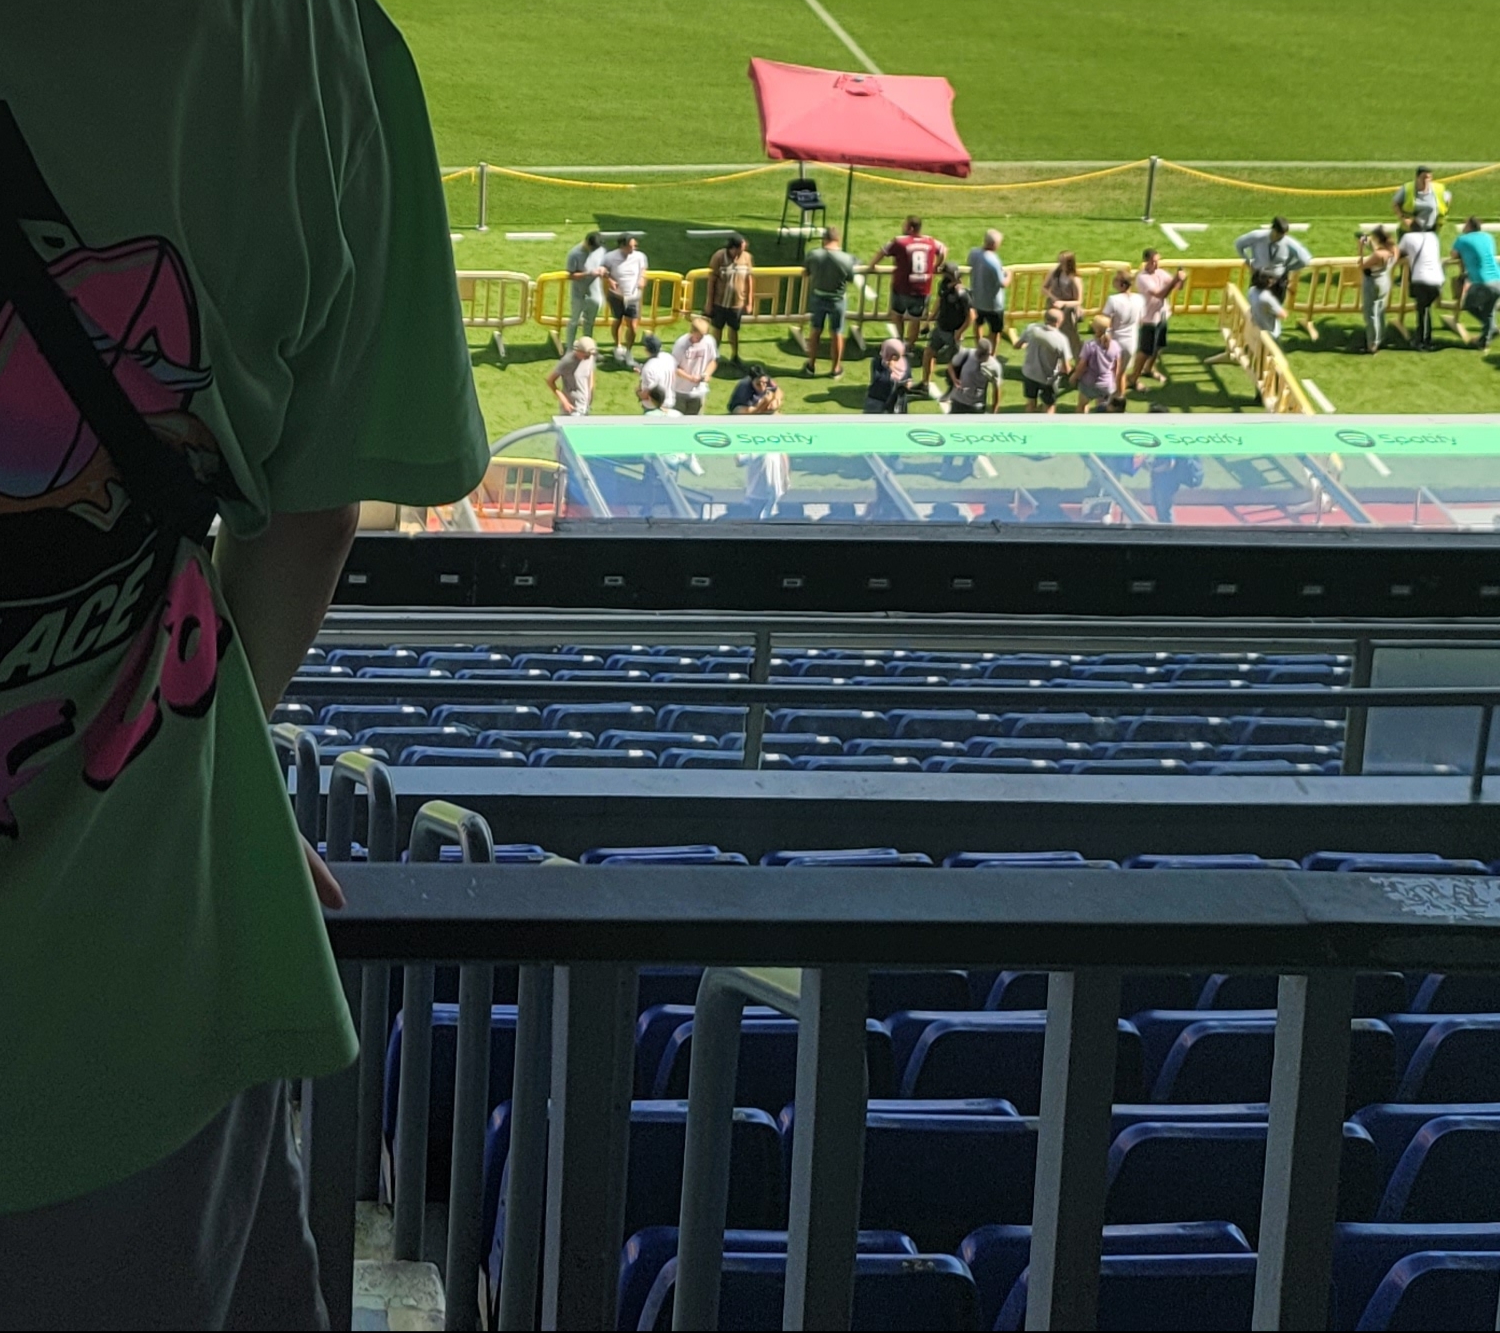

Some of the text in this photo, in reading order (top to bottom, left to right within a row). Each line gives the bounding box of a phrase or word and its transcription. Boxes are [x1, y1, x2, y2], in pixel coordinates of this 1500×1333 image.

[737, 432, 1458, 446] Spotify Spotify Spotify Spotify
